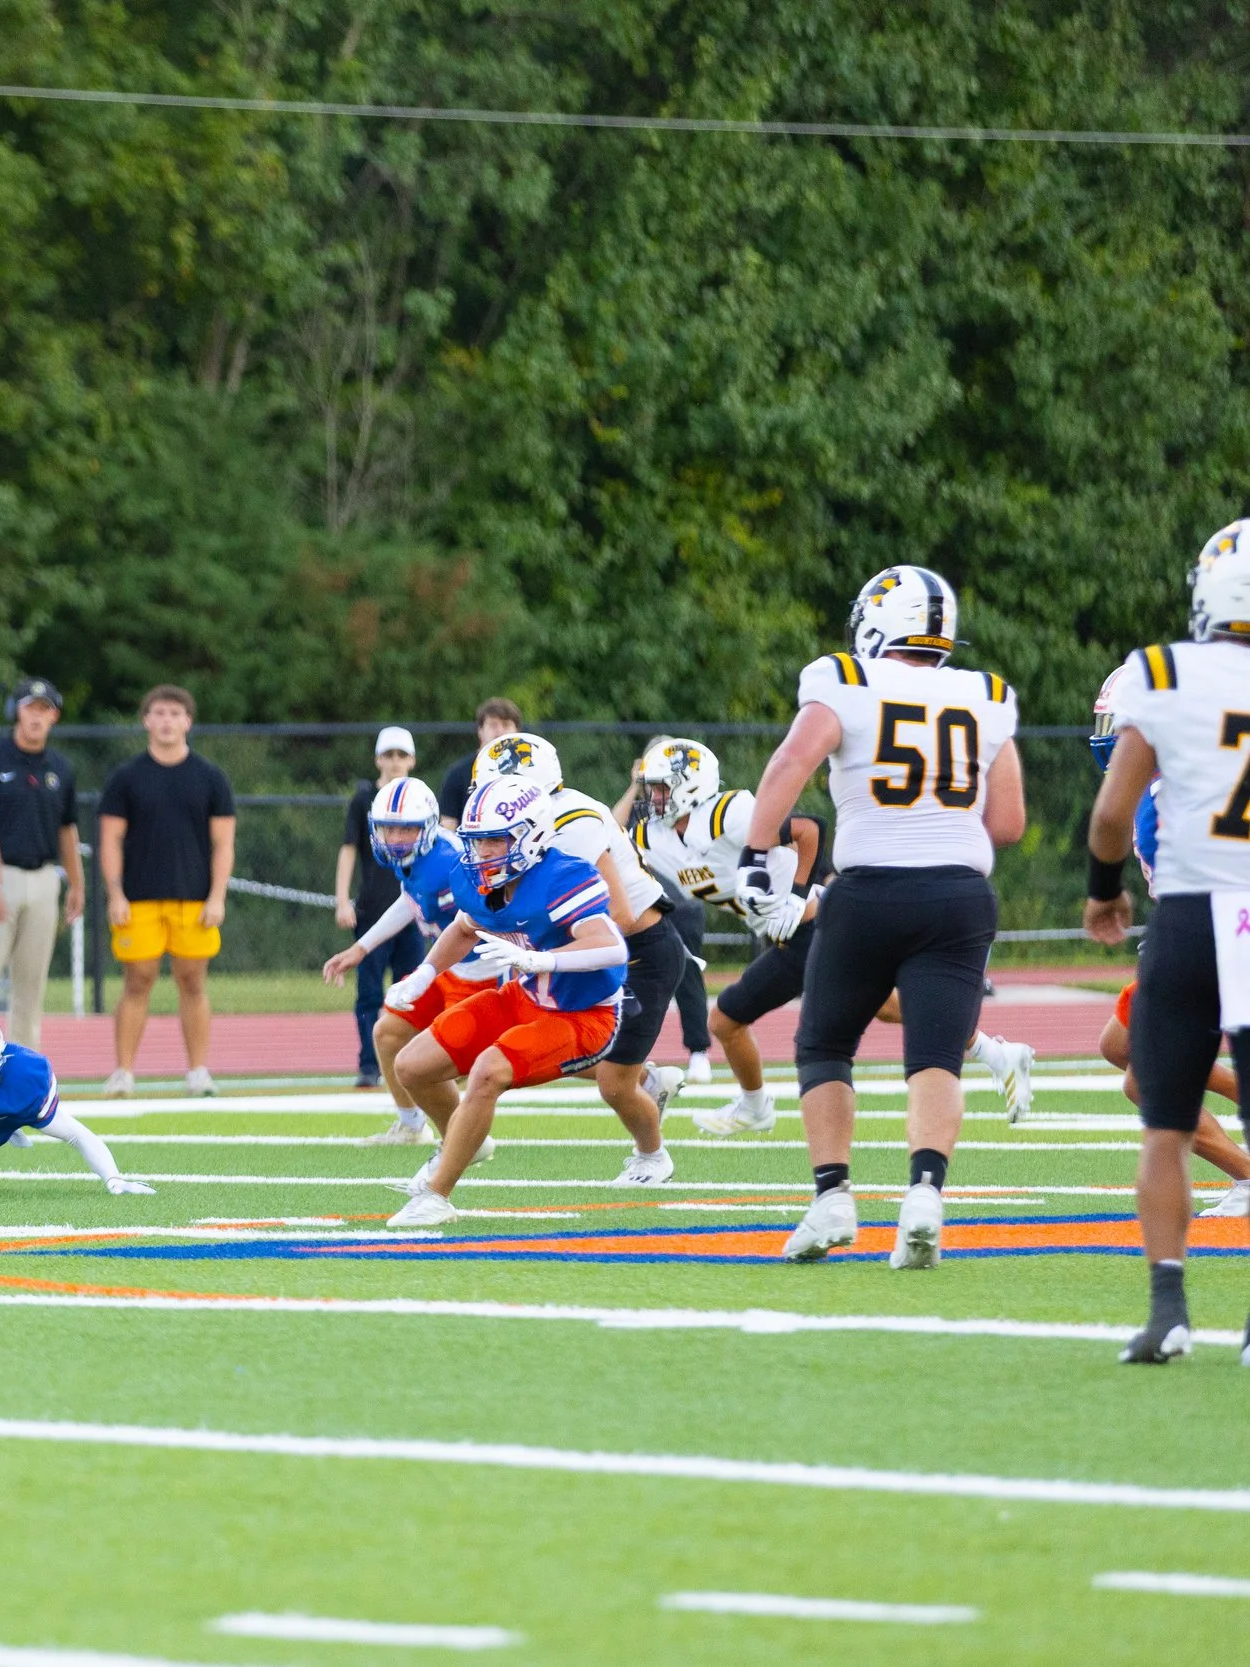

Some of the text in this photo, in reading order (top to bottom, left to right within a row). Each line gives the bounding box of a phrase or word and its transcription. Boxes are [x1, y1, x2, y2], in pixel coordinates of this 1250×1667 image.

[869, 699, 980, 811] 50
[494, 785, 542, 822] Bruins
[677, 864, 716, 887] NEERS
